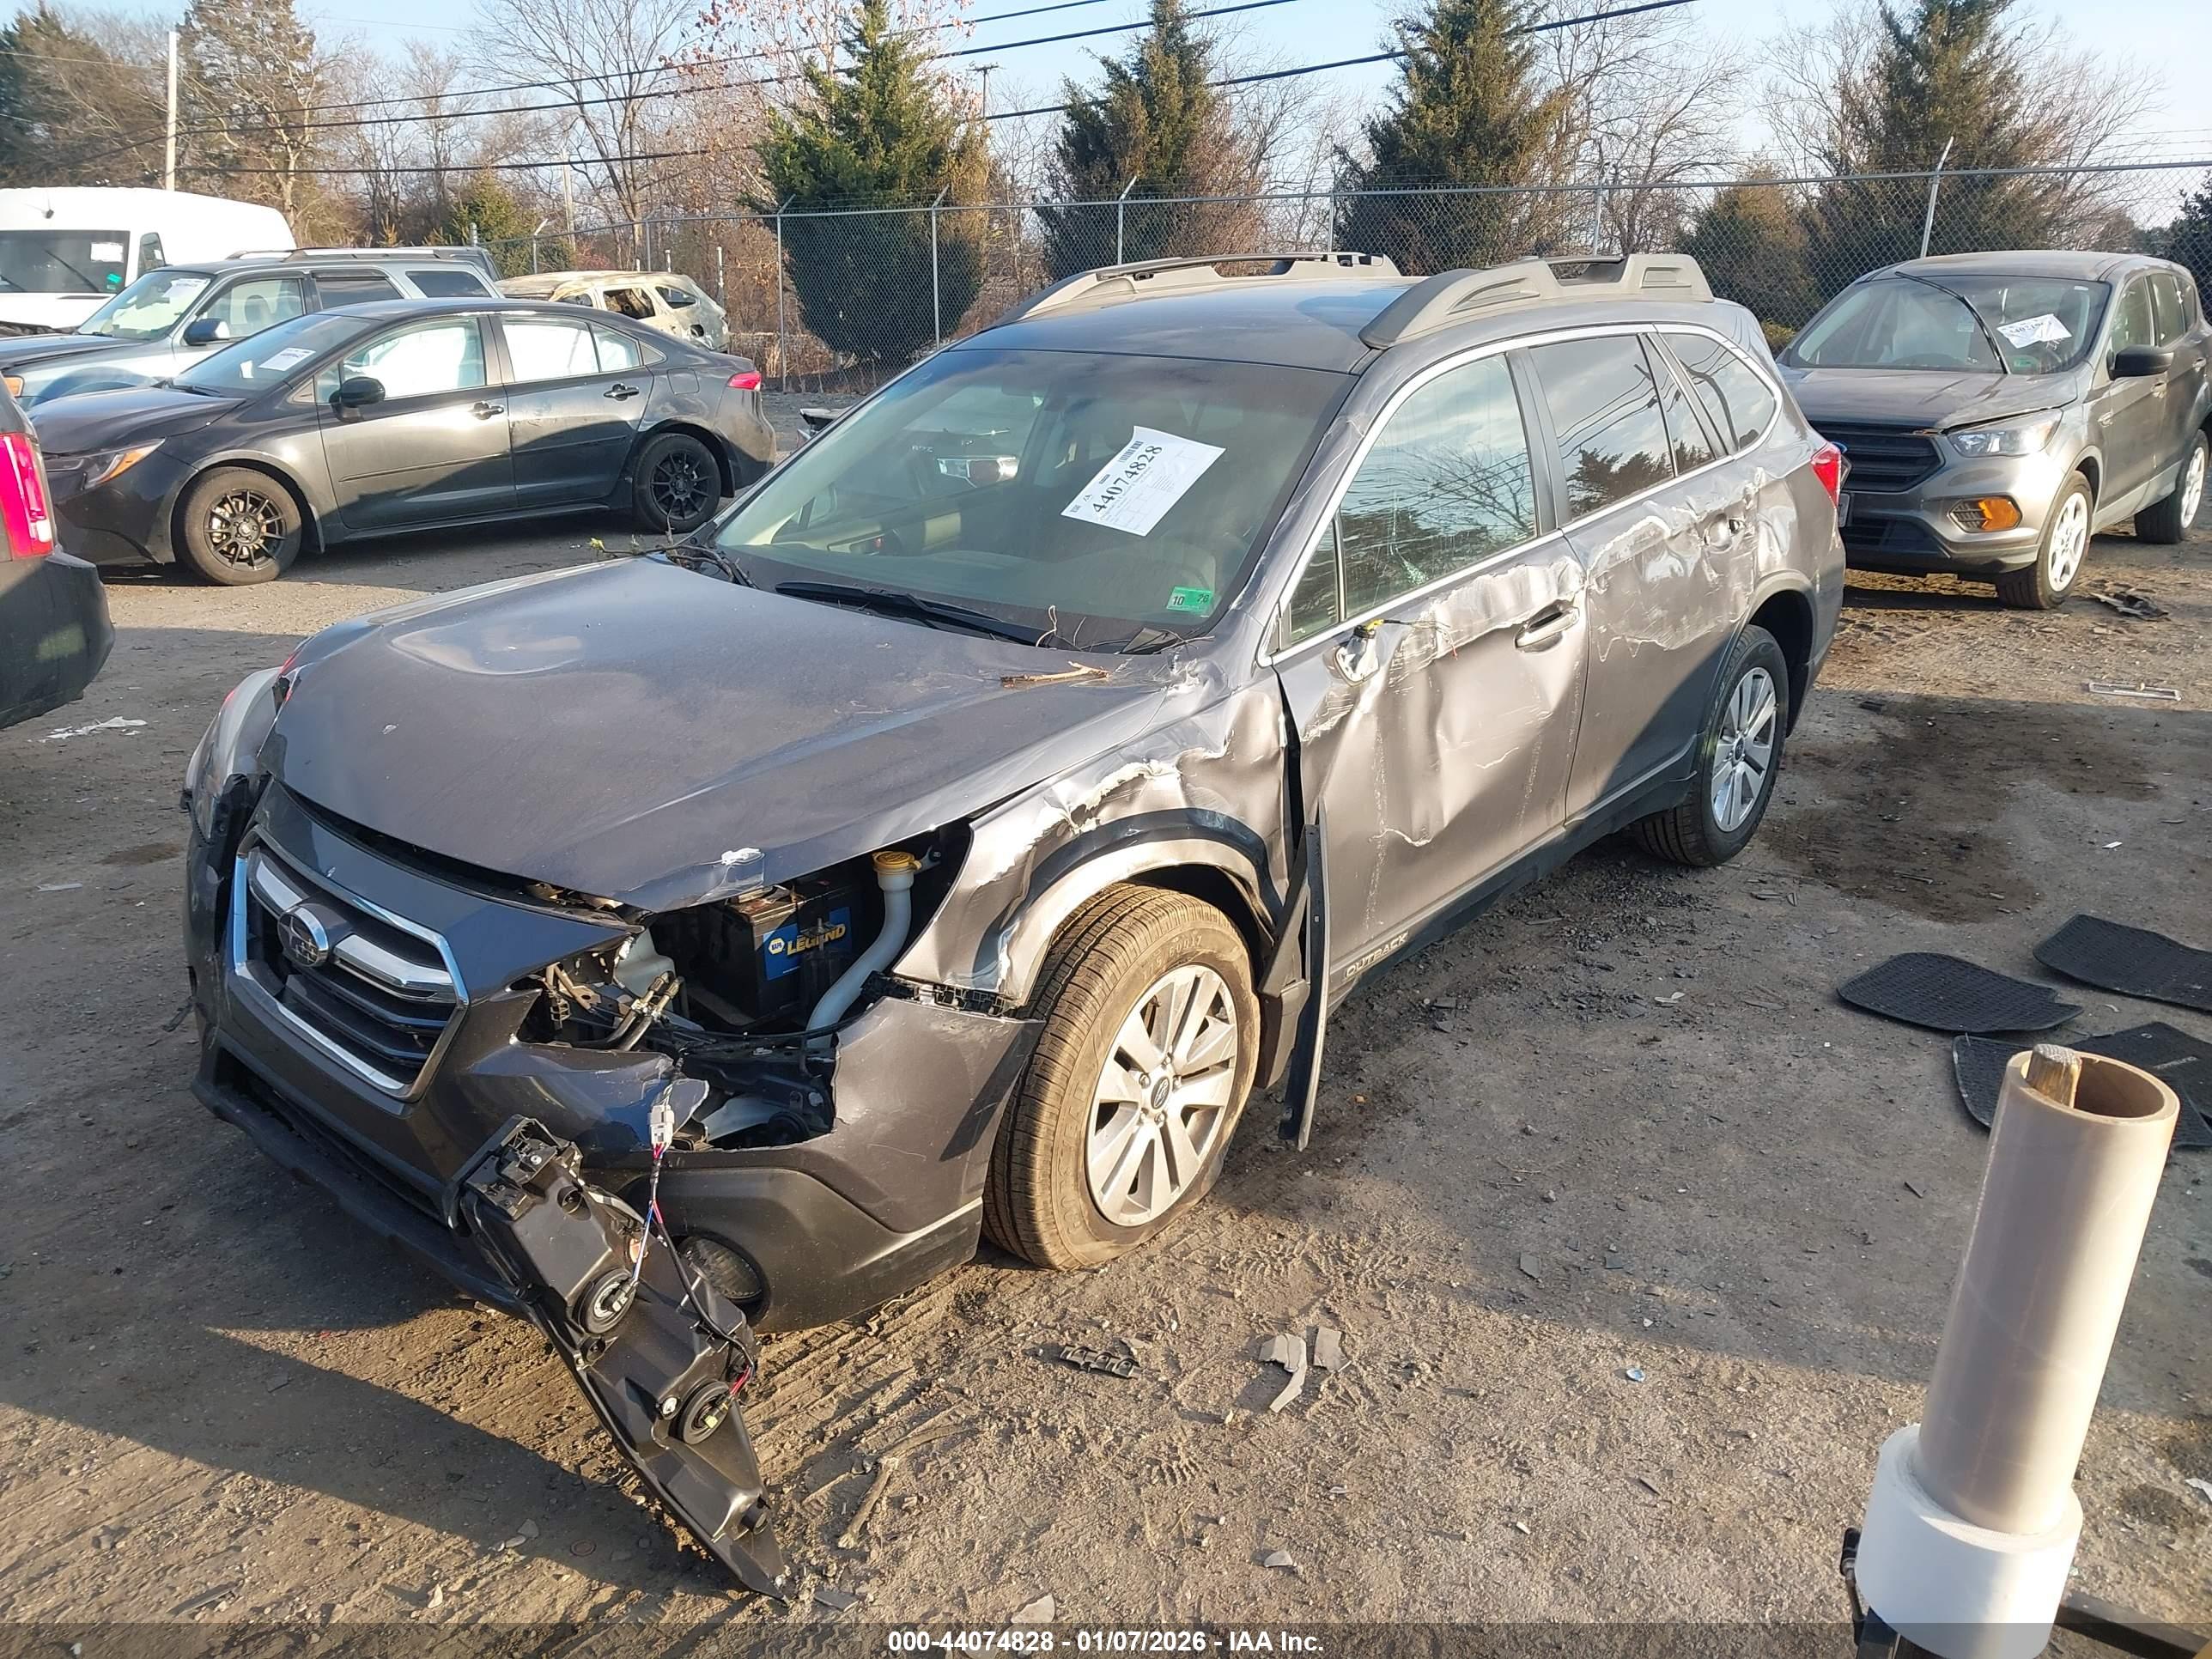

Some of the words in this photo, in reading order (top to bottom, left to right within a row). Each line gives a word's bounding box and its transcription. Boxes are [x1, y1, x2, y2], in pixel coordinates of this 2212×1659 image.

[1092, 445, 1163, 514] 44074828
[1173, 595, 1185, 606] 10
[1345, 931, 1409, 977] OUTBACK
